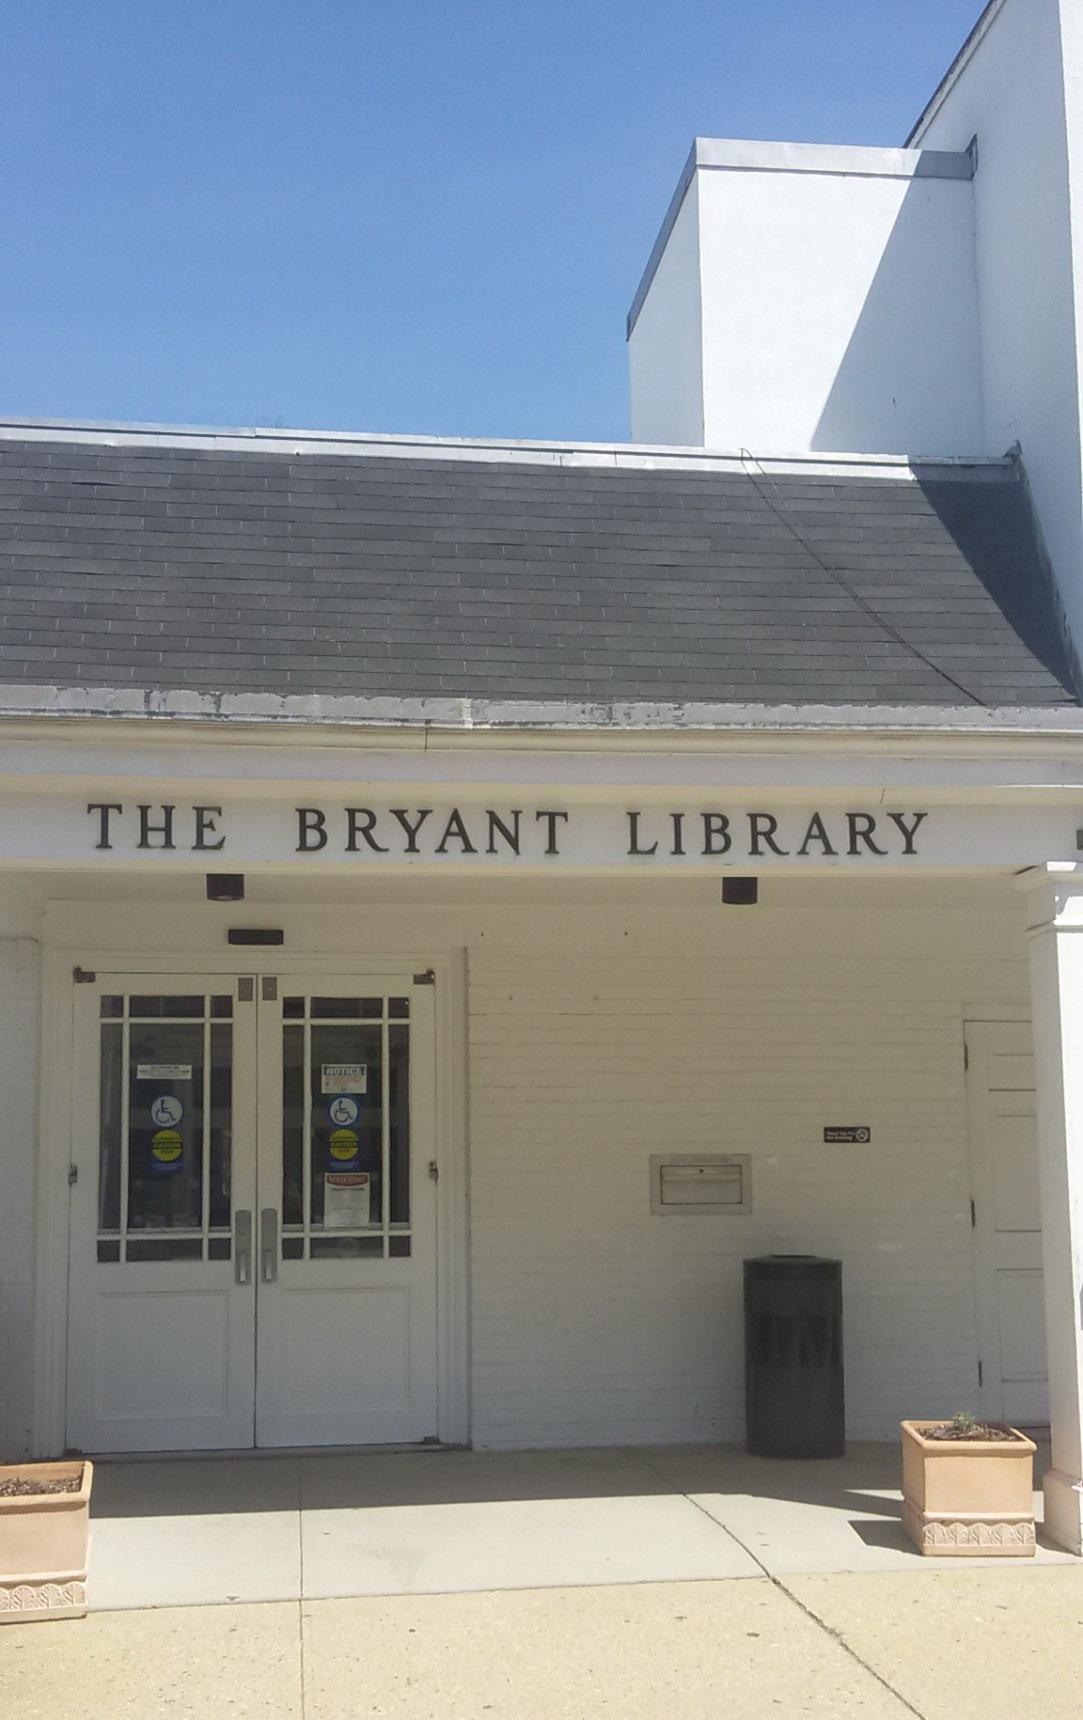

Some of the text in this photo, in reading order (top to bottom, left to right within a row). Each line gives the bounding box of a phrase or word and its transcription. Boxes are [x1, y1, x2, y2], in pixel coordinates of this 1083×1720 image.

[87, 804, 928, 858] THE BRYANT LIBRARY
[326, 1067, 361, 1075] NOTICE
